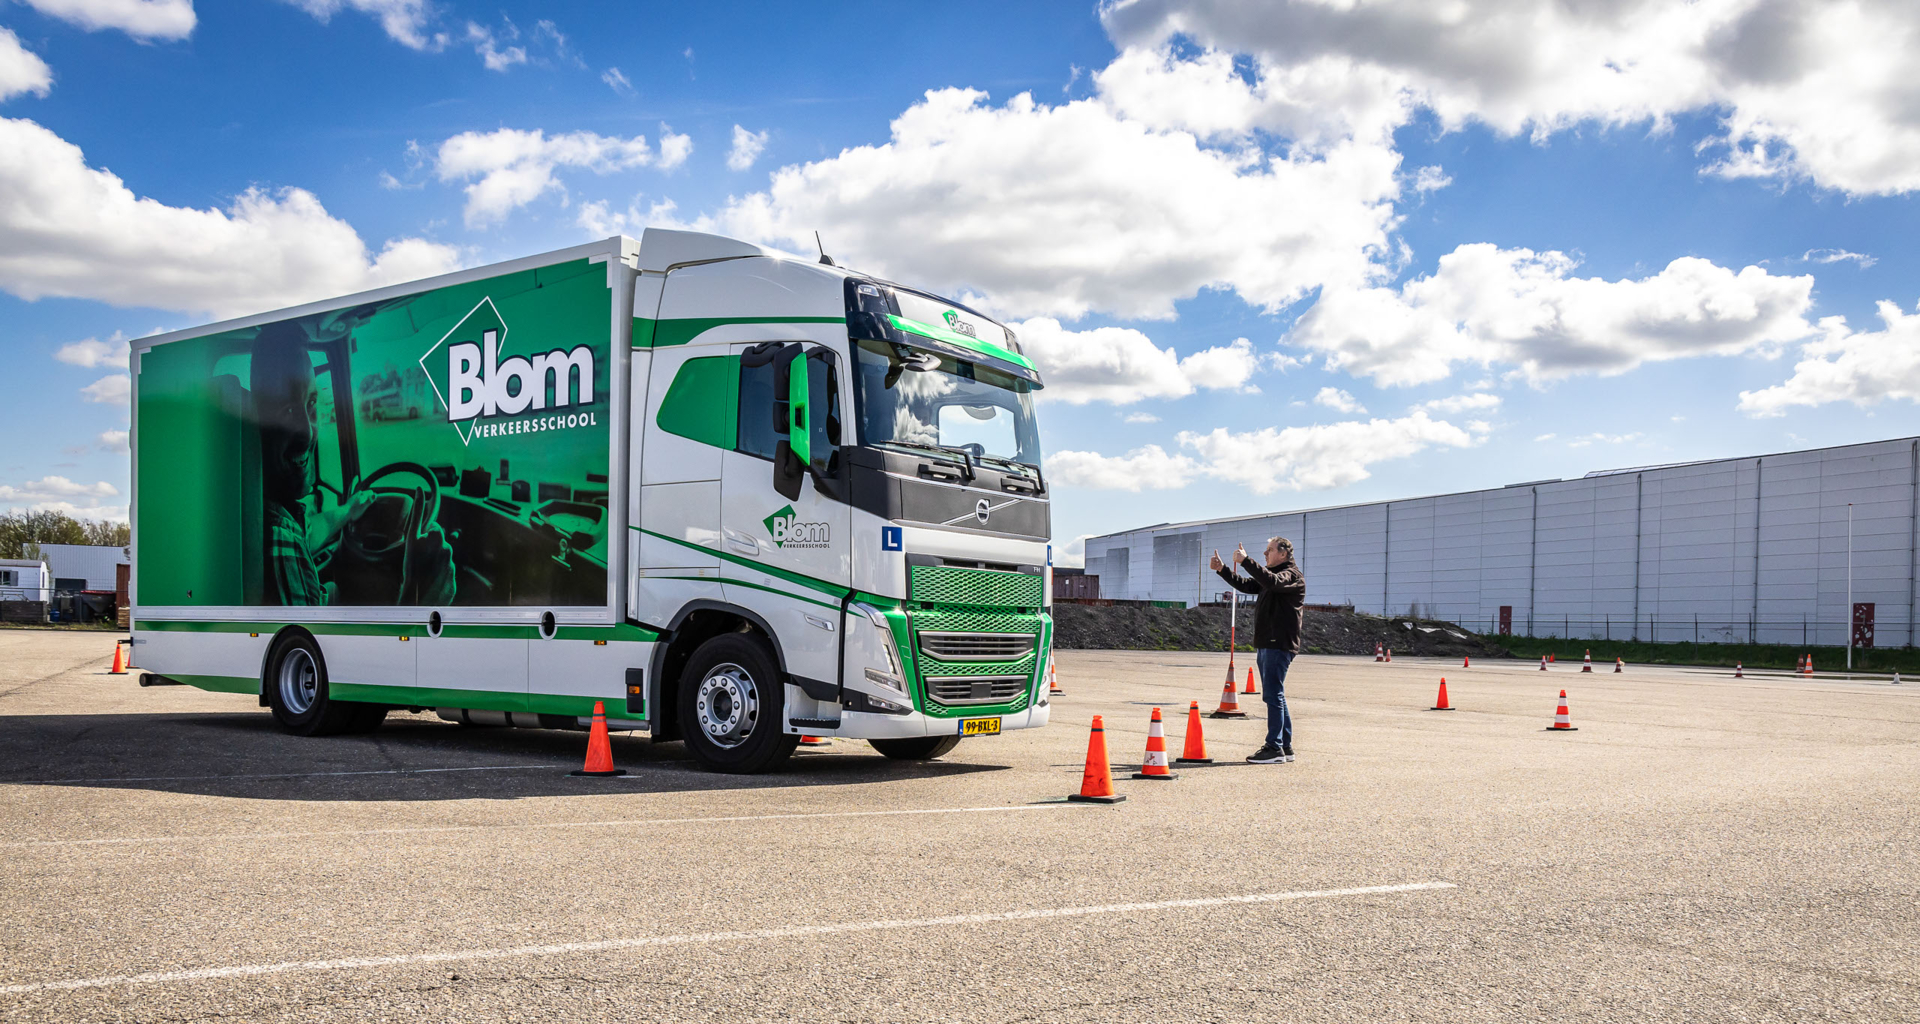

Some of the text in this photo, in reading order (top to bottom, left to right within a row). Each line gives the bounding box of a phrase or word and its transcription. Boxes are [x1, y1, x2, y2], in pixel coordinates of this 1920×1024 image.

[947, 313, 976, 336] Blom
[449, 329, 594, 422] Blom
[474, 412, 597, 438] VERKEERSSCHOOL
[773, 514, 830, 543] Blom
[888, 531, 897, 547] L
[966, 720, 998, 732] 99-BXL-3
